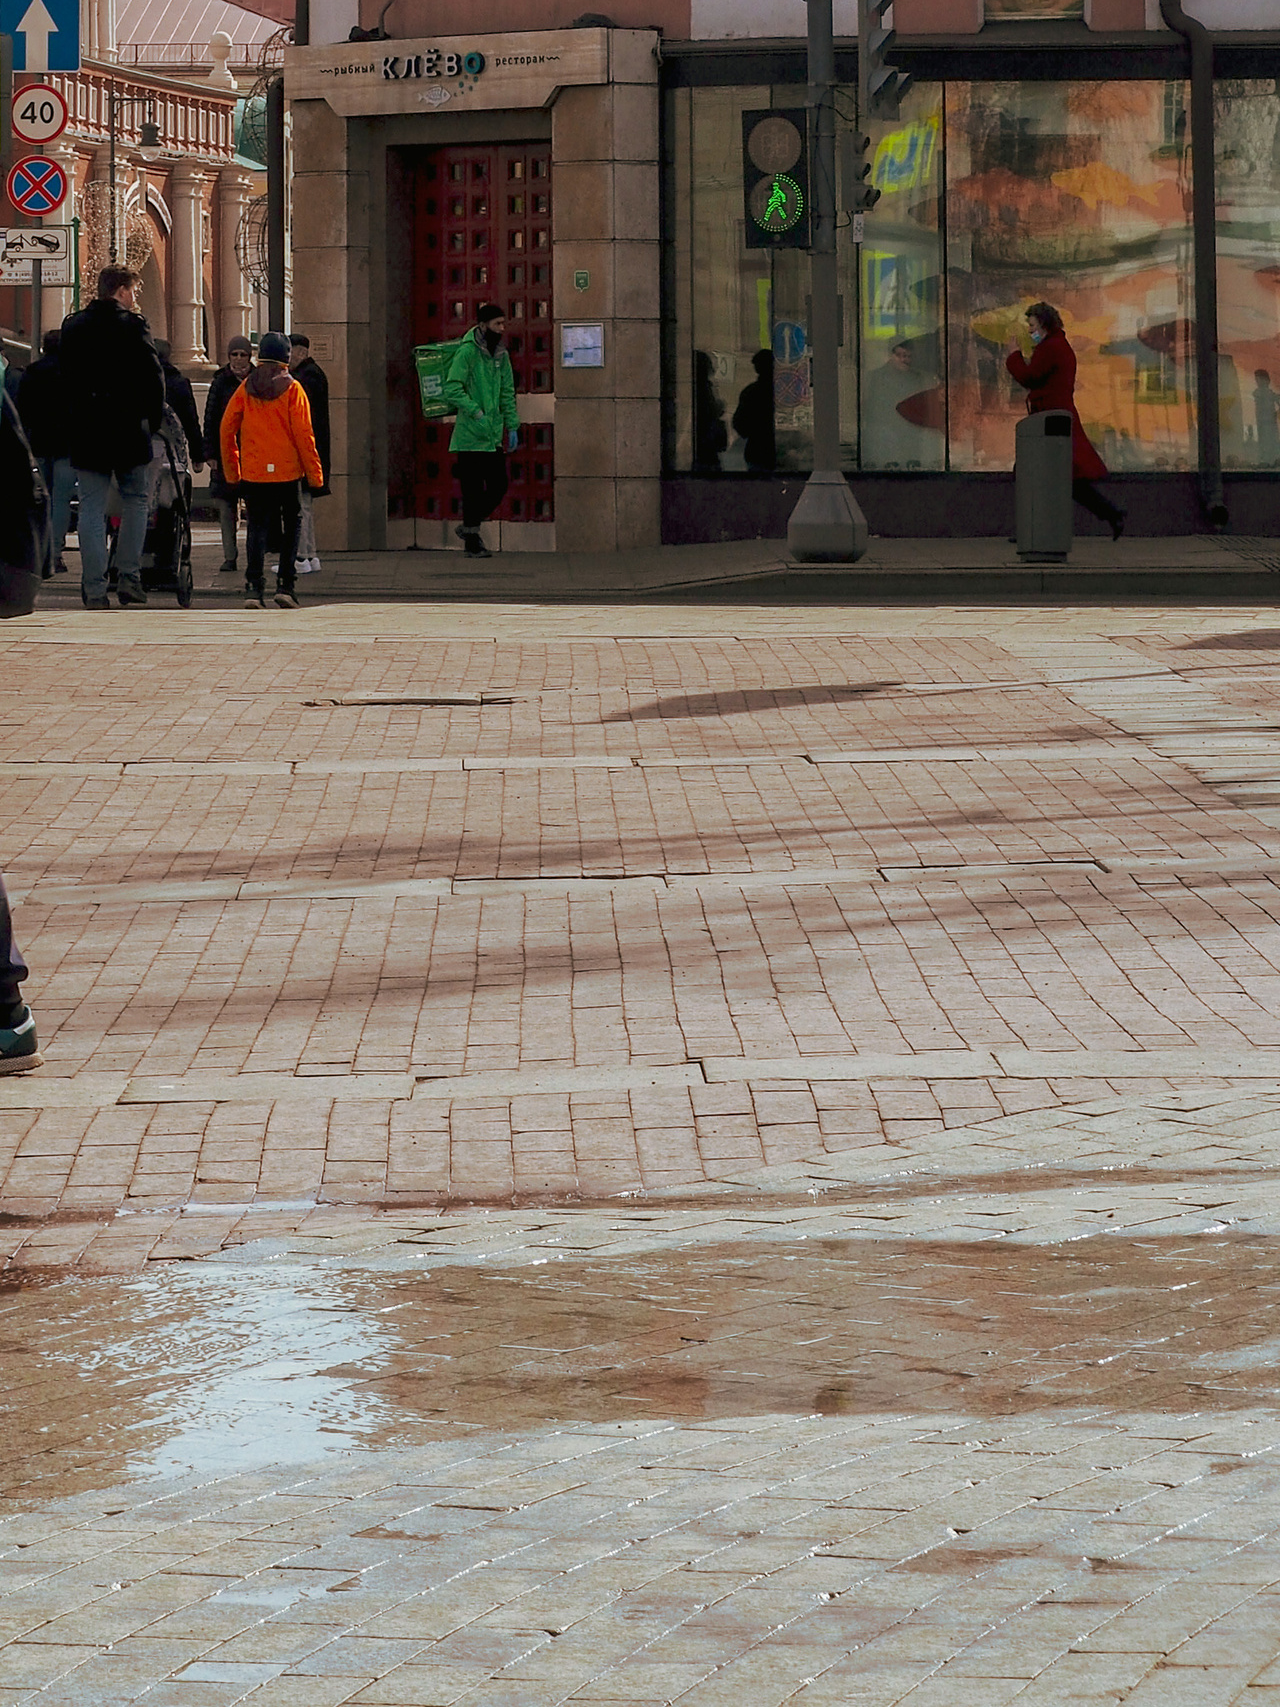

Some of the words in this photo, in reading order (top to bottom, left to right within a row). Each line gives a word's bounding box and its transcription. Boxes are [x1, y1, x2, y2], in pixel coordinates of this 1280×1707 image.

[333, 63, 376, 77] рыбный
[381, 48, 486, 80] КЛЁВО
[495, 54, 546, 68] ресторан
[20, 101, 55, 124] 40
